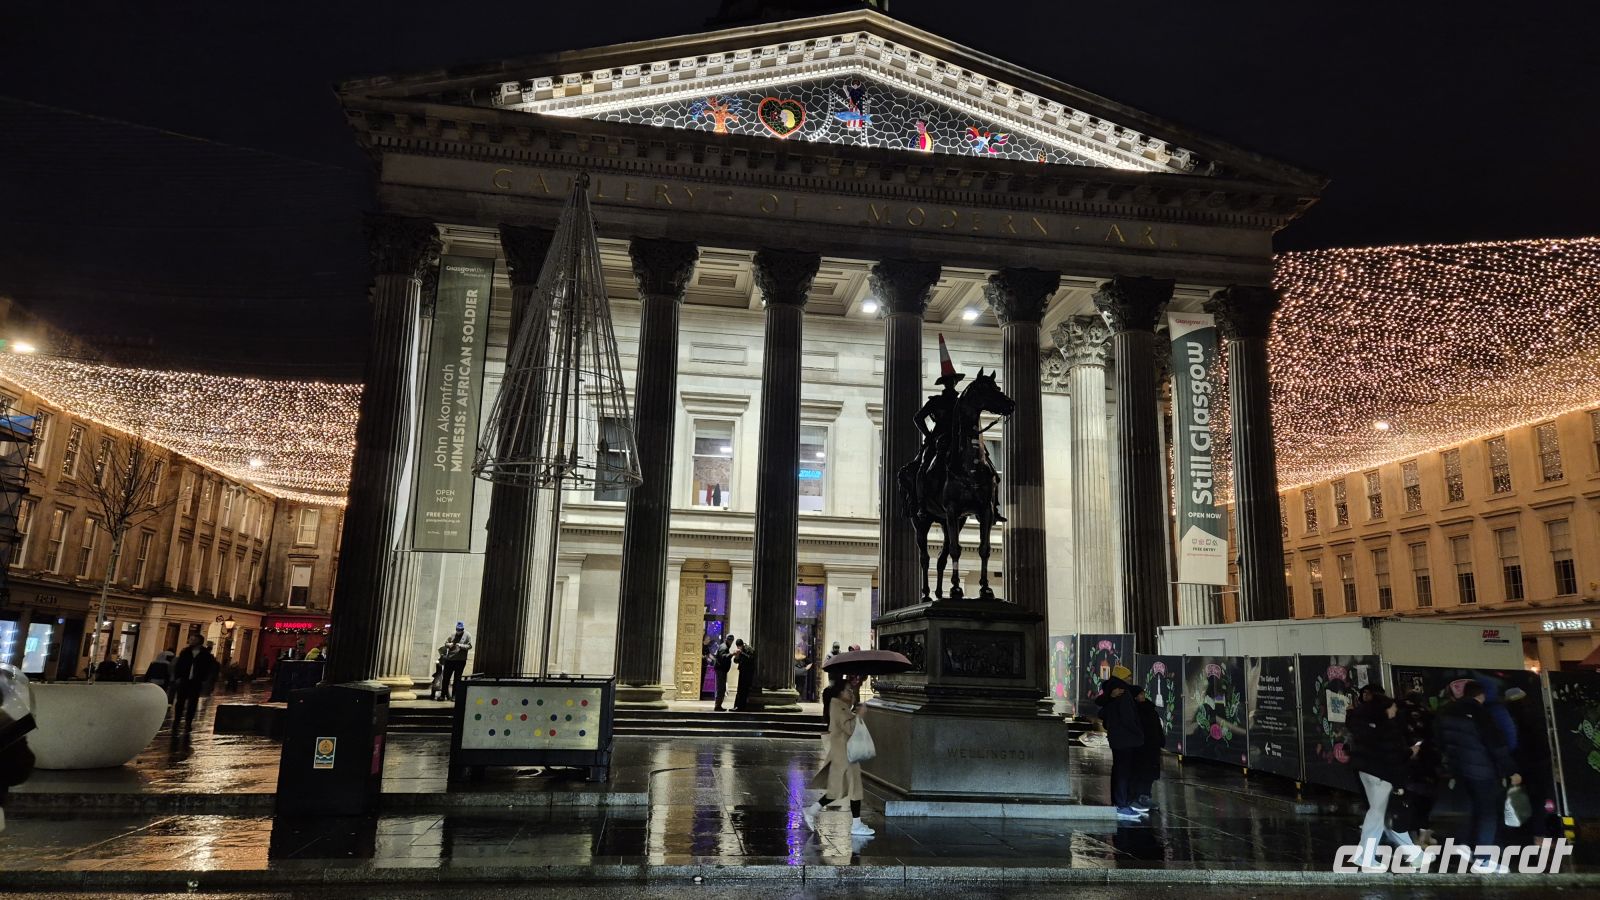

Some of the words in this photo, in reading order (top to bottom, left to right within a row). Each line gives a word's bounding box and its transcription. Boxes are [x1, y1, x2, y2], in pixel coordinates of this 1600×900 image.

[864, 202, 1049, 235] MODERN
[1104, 222, 1183, 247] ART
[462, 289, 478, 343] SOLDIER
[437, 364, 455, 432] Akomfrah
[456, 347, 472, 407] AFRICAN
[1187, 341, 1212, 451] Glasgow
[433, 436, 448, 471] John
[450, 411, 466, 472] MIMESIS:
[1190, 456, 1212, 505] Still
[1543, 620, 1566, 632] COTA
[947, 747, 1035, 760] WELLINGTON
